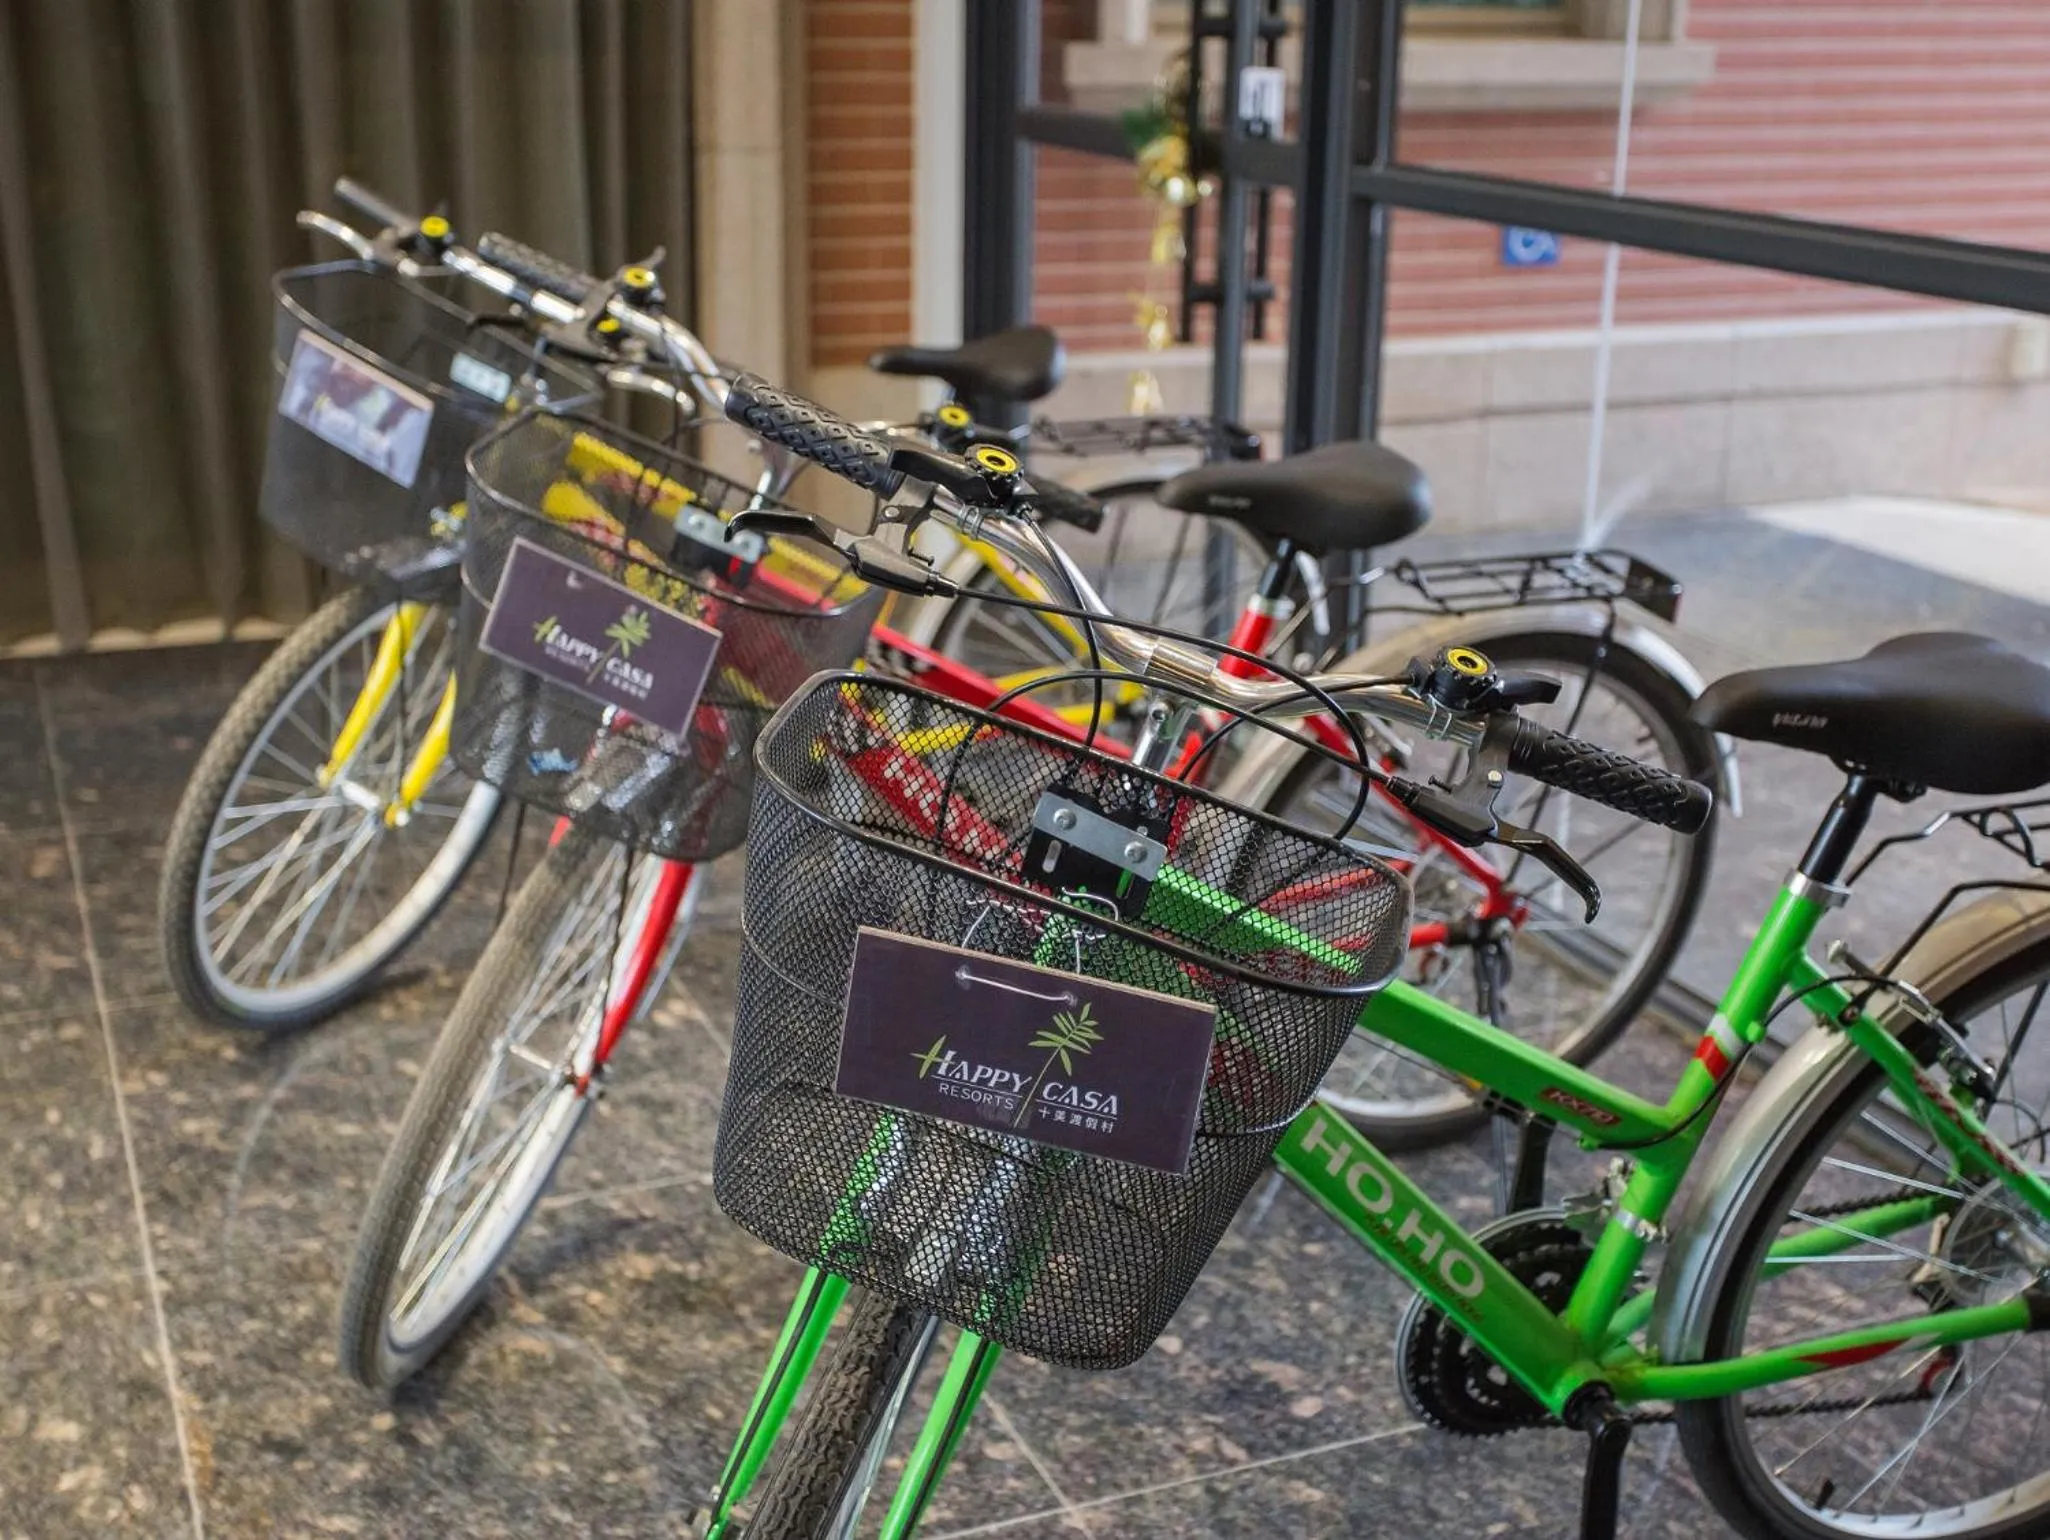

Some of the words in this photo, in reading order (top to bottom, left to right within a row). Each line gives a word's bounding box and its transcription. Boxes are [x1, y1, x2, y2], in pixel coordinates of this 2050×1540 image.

[532, 616, 604, 664] HAPPY
[606, 657, 654, 690] CASA
[909, 1034, 1033, 1093] HAPPY
[1042, 1081, 1118, 1116] CASA
[939, 1082, 1015, 1110] RESORTS
[1301, 1117, 1485, 1299] HO.HO
